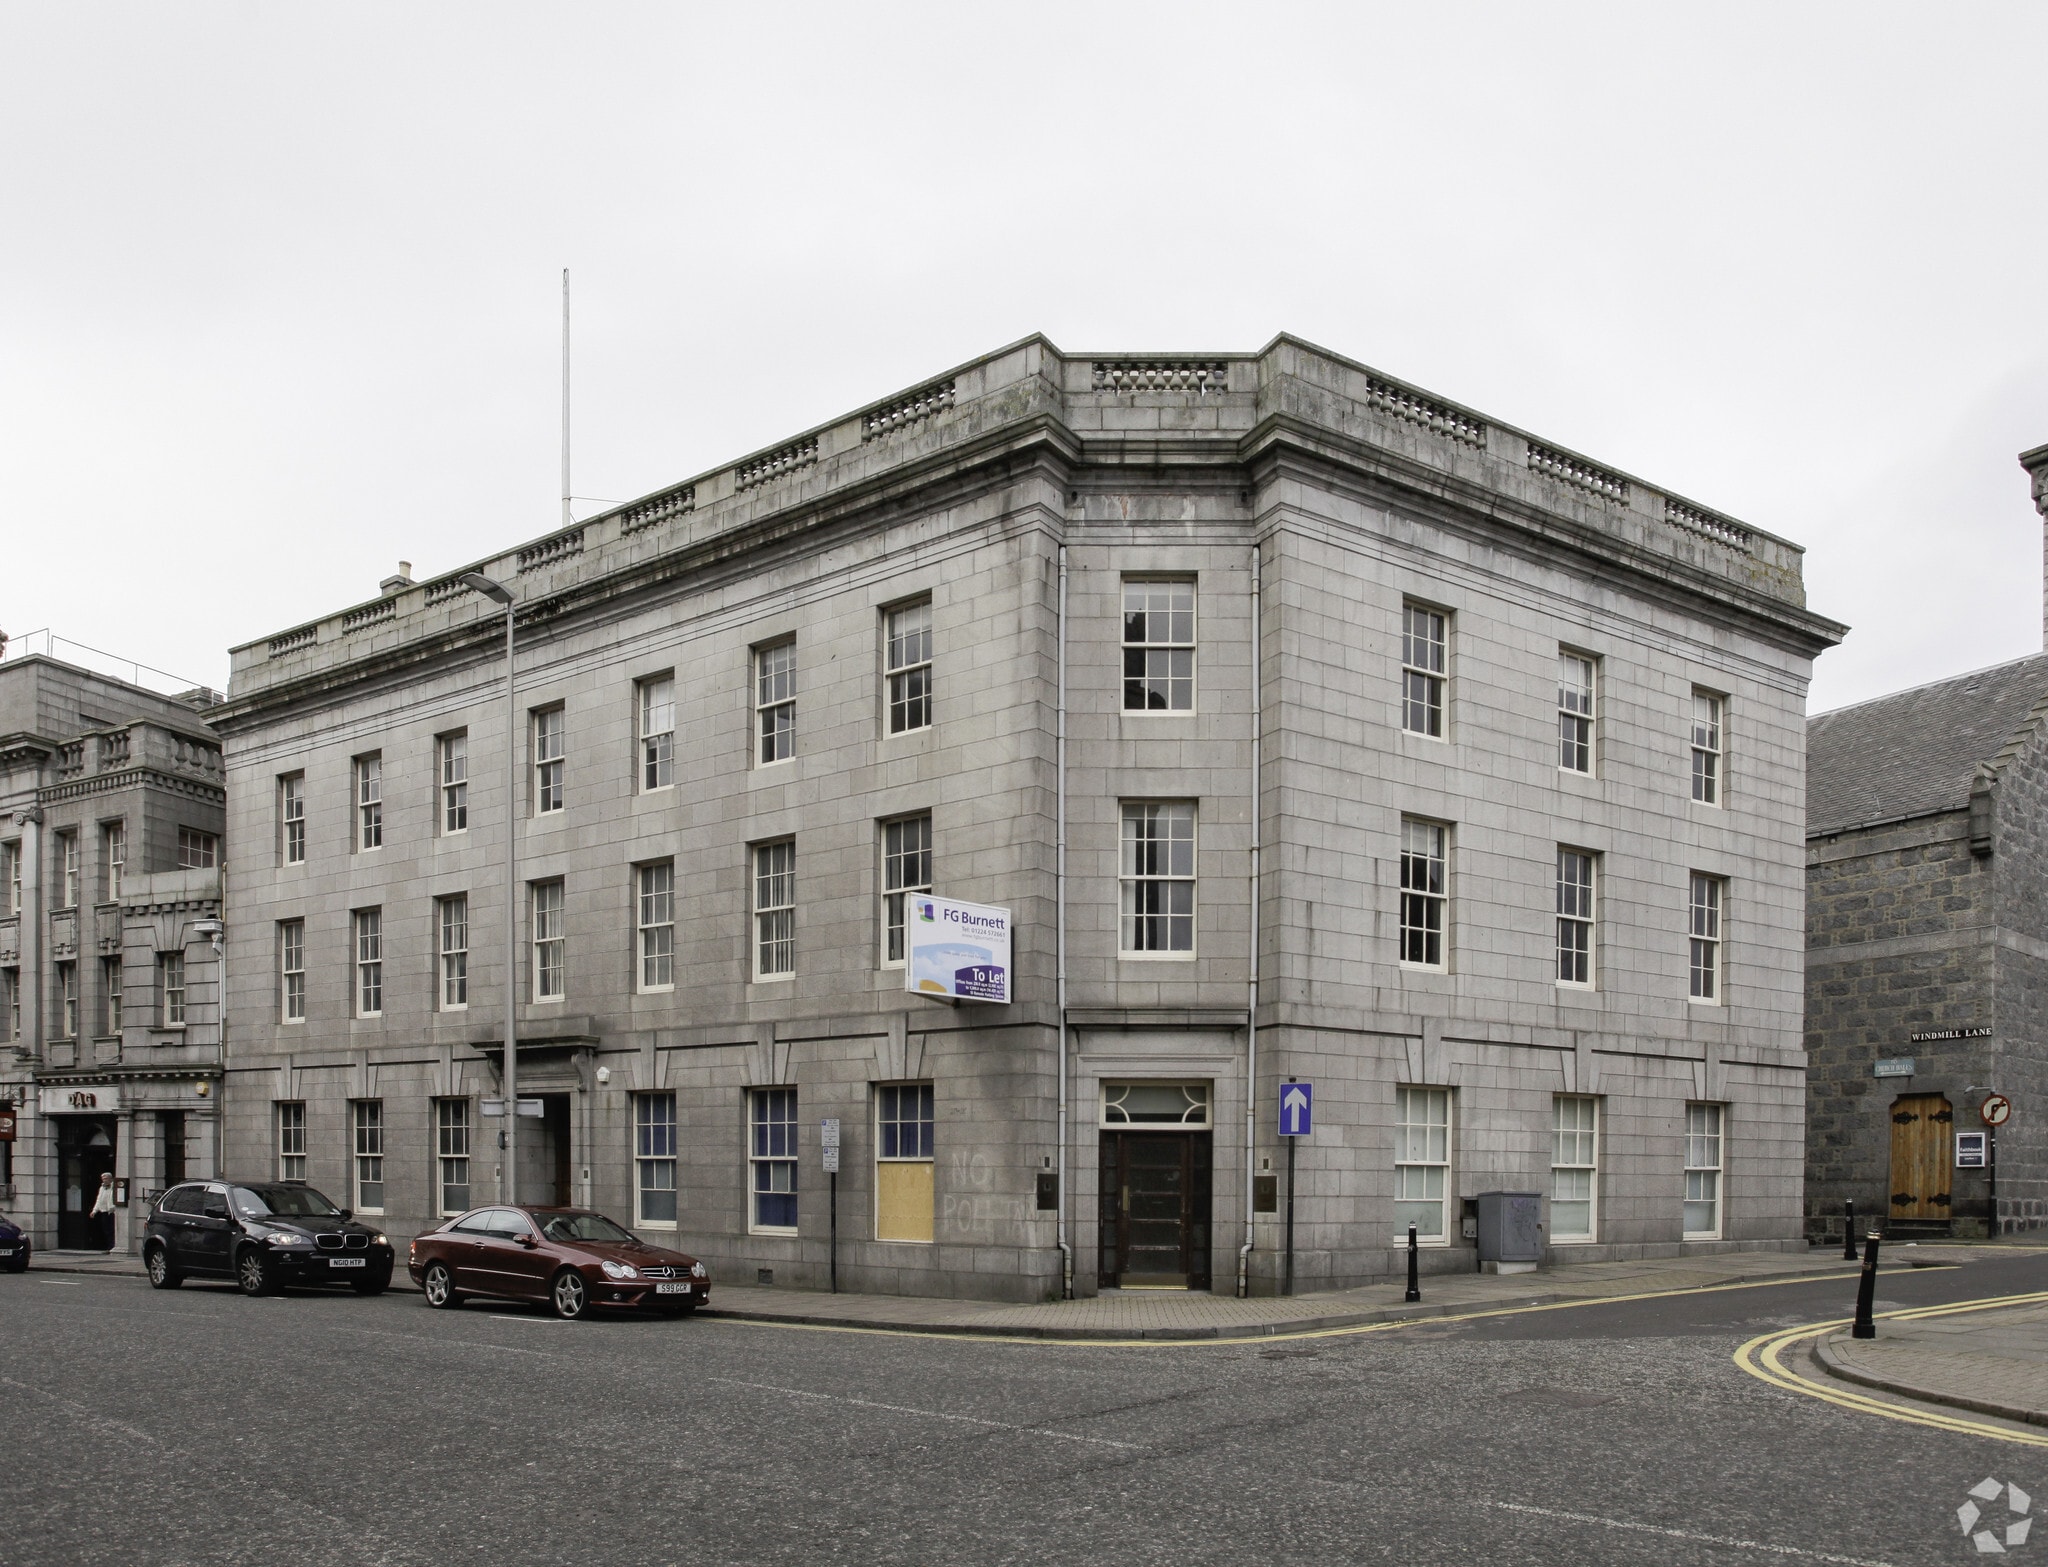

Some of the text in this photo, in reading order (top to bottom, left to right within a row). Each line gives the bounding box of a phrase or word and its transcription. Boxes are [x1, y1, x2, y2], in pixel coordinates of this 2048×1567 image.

[944, 908, 1005, 930] FG Burnett
[970, 927, 987, 935] 01224
[972, 967, 985, 982] To
[989, 969, 1005, 985] Let
[1911, 1027, 1992, 1041] WINDMILL LANE
[951, 1150, 987, 1187] NO
[661, 1284, 674, 1293] S99
